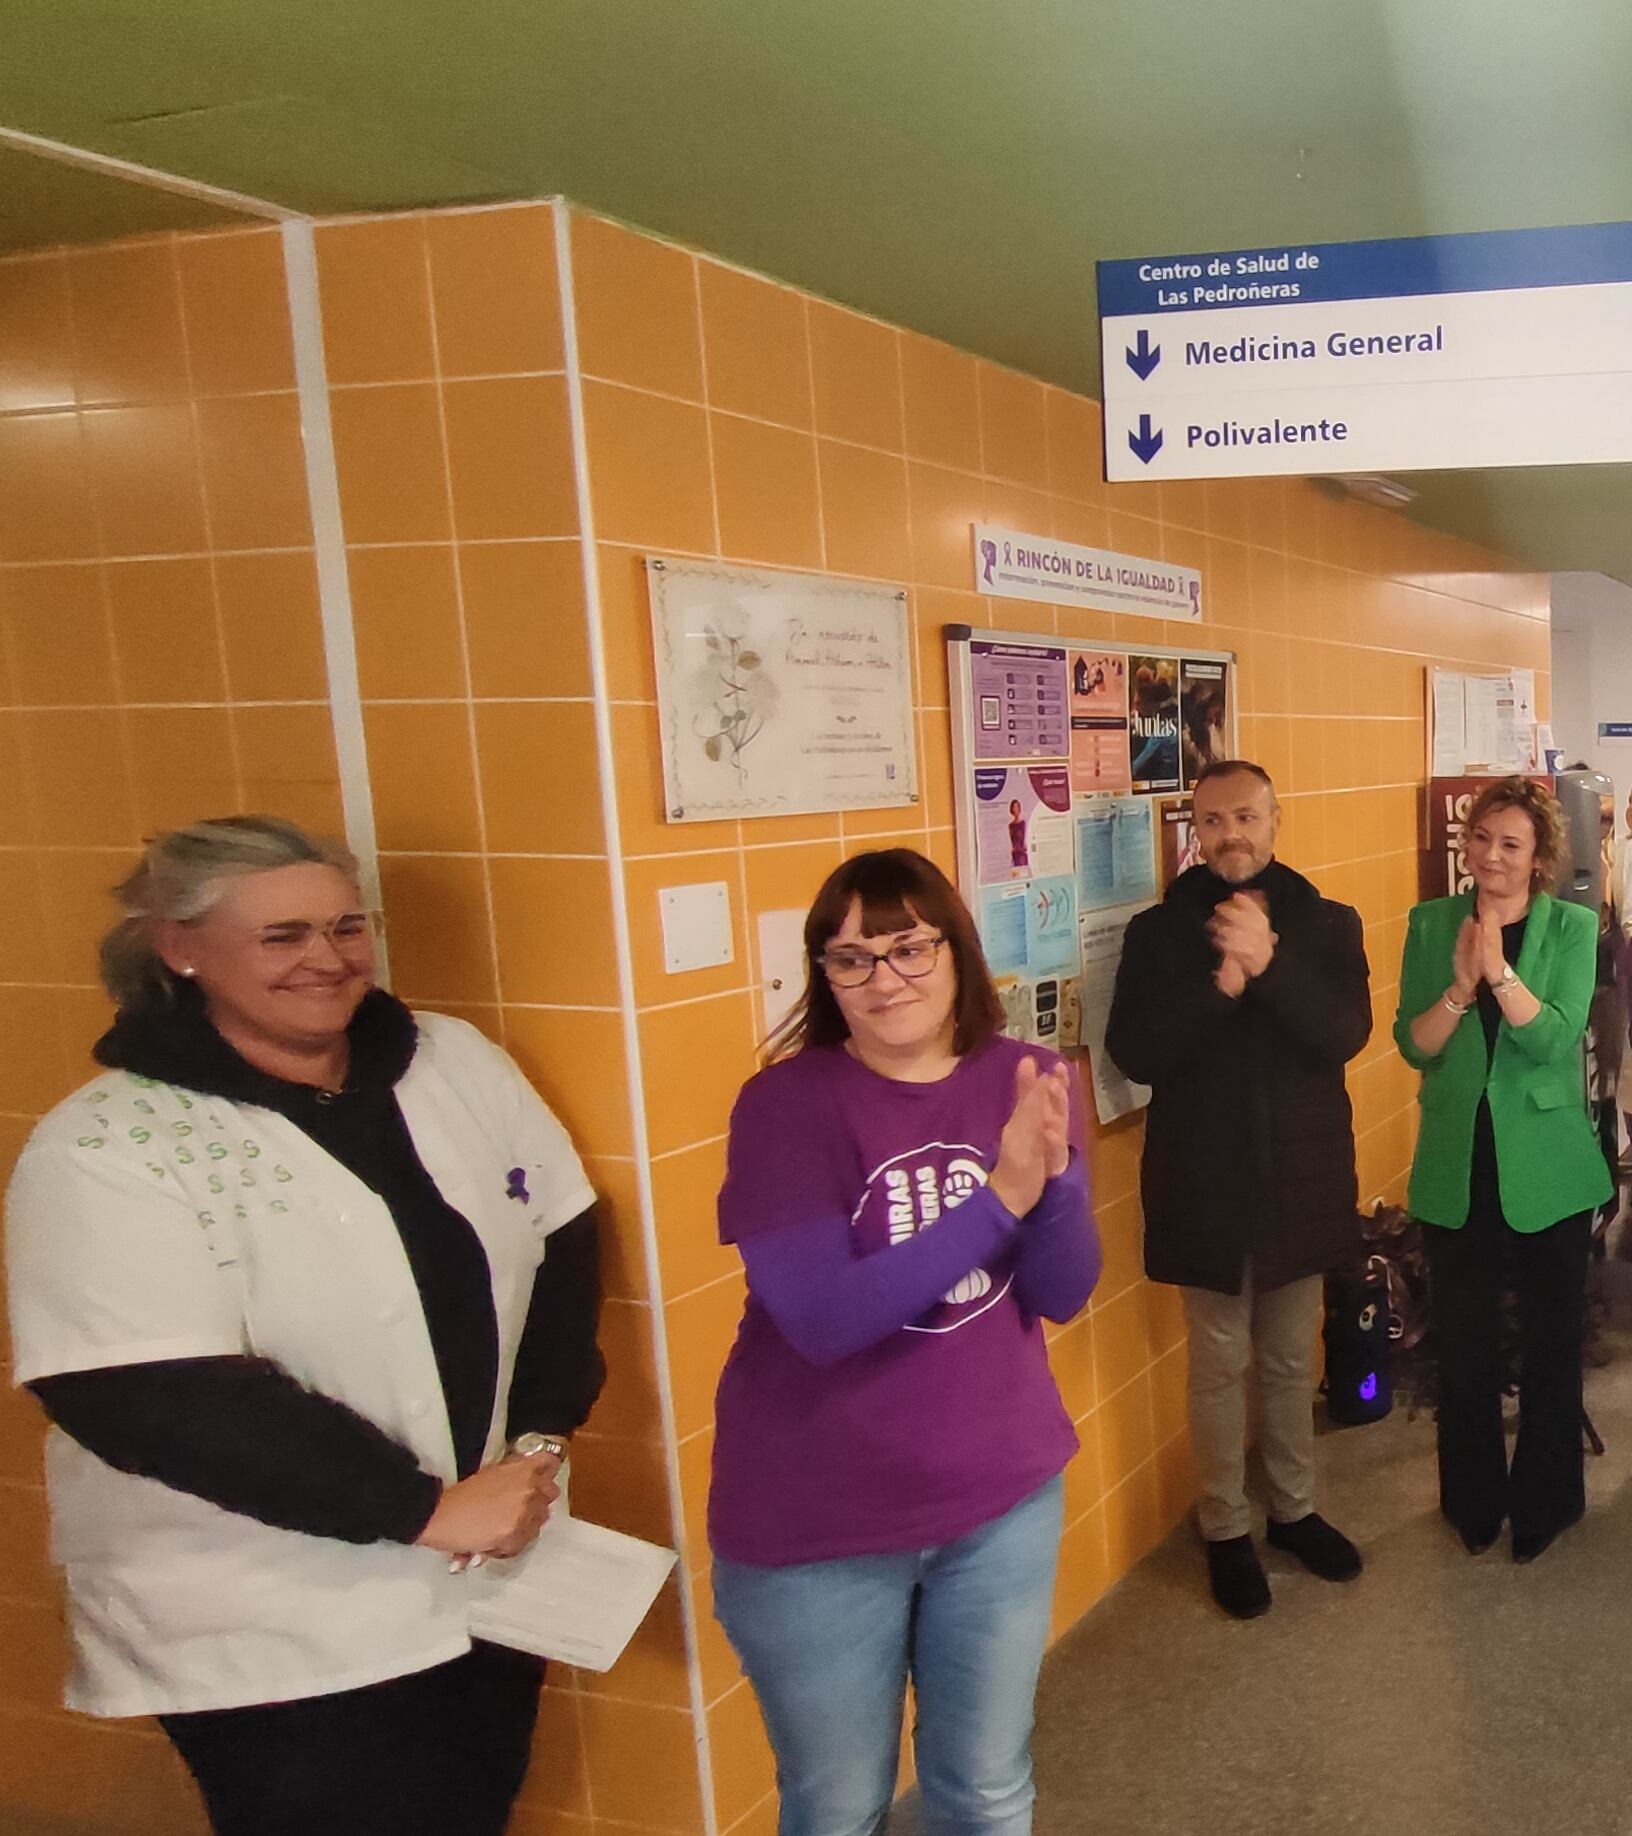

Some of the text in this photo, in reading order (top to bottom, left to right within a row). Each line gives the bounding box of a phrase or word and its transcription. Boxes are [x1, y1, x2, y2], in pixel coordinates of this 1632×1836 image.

[1139, 251, 1319, 282] Centro de Salud de
[1158, 281, 1300, 307] Las Pedroñeras
[1185, 325, 1444, 366] Medicina General
[1187, 417, 1348, 448] Polivalente
[1017, 548, 1072, 576] RINCÓN
[1076, 561, 1093, 580] DE
[1097, 564, 1113, 584] LA
[1117, 567, 1175, 594] IGUALDAD
